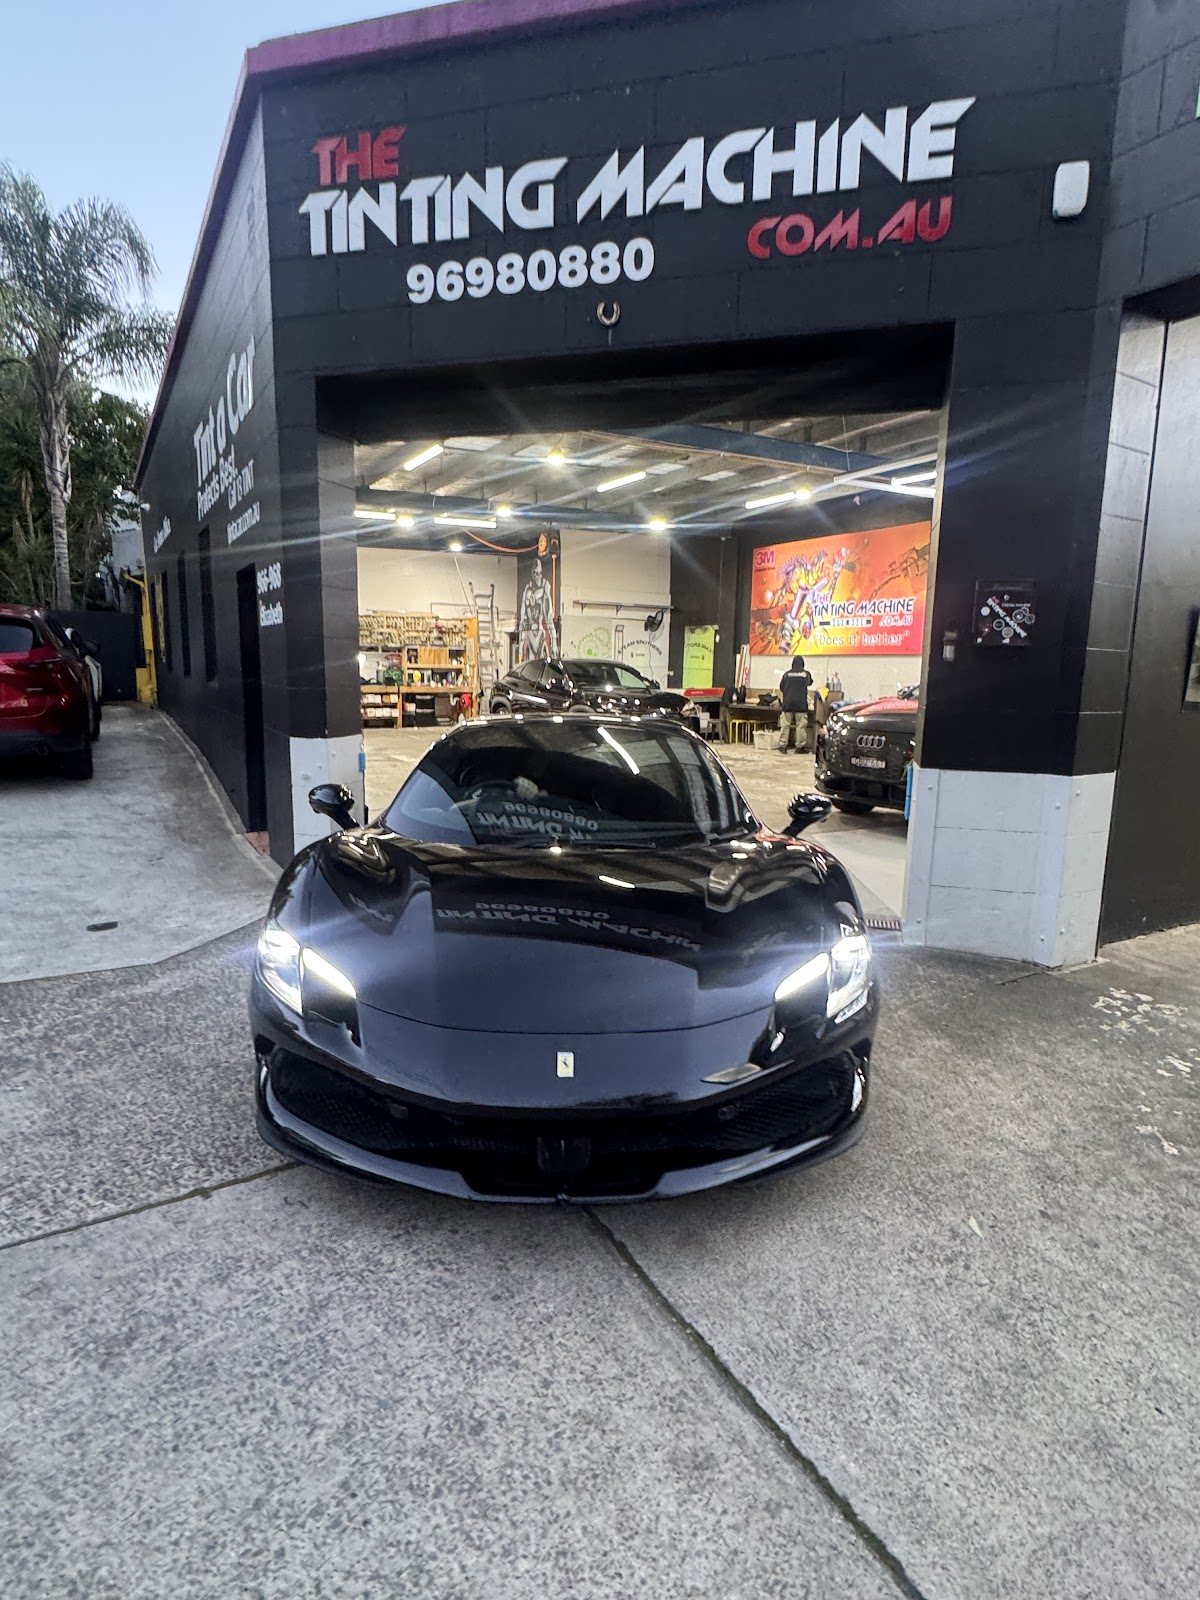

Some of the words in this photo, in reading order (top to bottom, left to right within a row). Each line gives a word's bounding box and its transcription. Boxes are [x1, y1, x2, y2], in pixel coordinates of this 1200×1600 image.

[299, 157, 568, 256] TINTING
[576, 97, 977, 223] MACHINE
[312, 125, 406, 187] THE
[747, 196, 953, 260] COM.AU
[406, 237, 655, 304] 96980880
[216, 396, 226, 454] a
[227, 335, 255, 435] Car
[755, 550, 775, 566] 3M
[813, 602, 854, 617] TINTING
[857, 598, 915, 615] MACHINE
[848, 633, 859, 646] it
